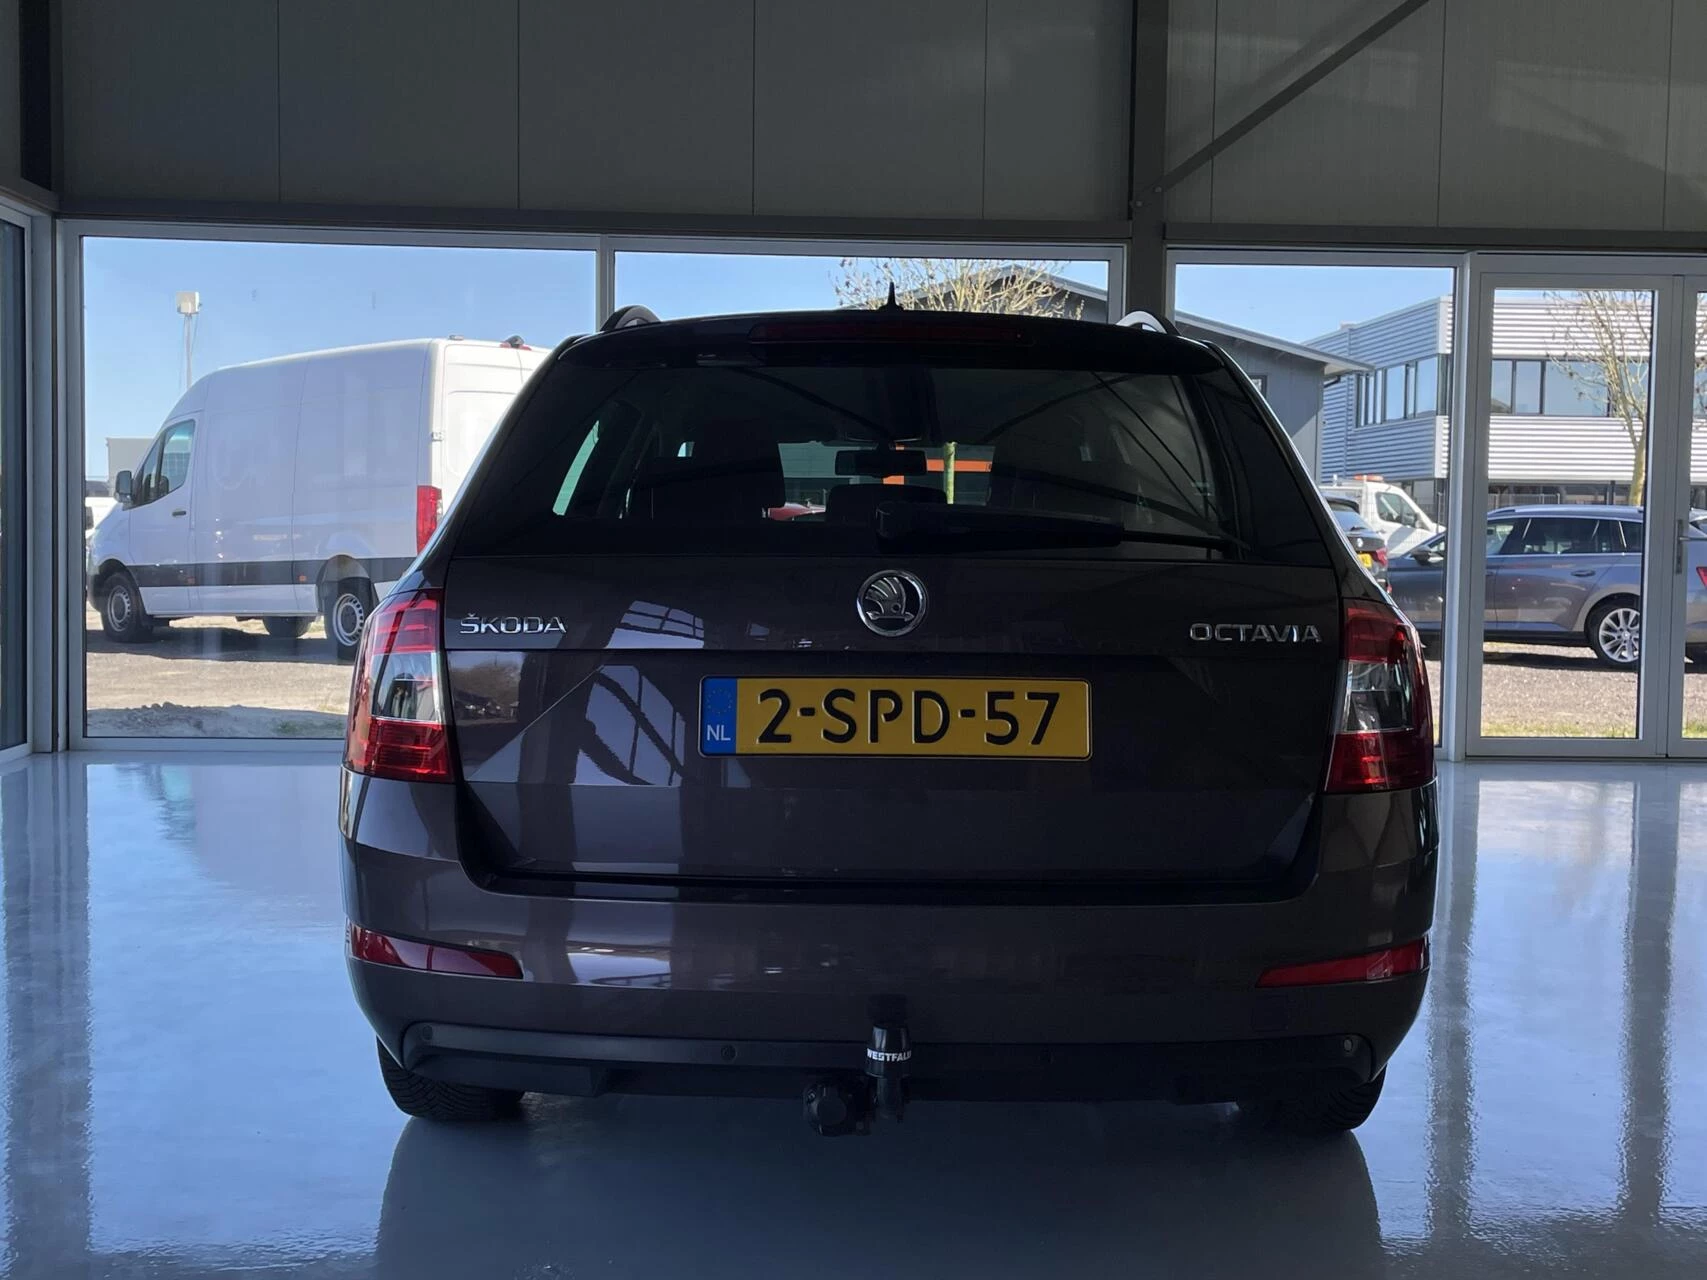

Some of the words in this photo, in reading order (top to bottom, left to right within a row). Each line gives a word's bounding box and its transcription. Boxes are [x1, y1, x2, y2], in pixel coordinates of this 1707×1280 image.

[460, 613, 567, 634] ŠKODA
[1189, 623, 1321, 642] OCTAVIA
[756, 688, 1061, 745] 2-SPD-57
[706, 725, 731, 741] NL
